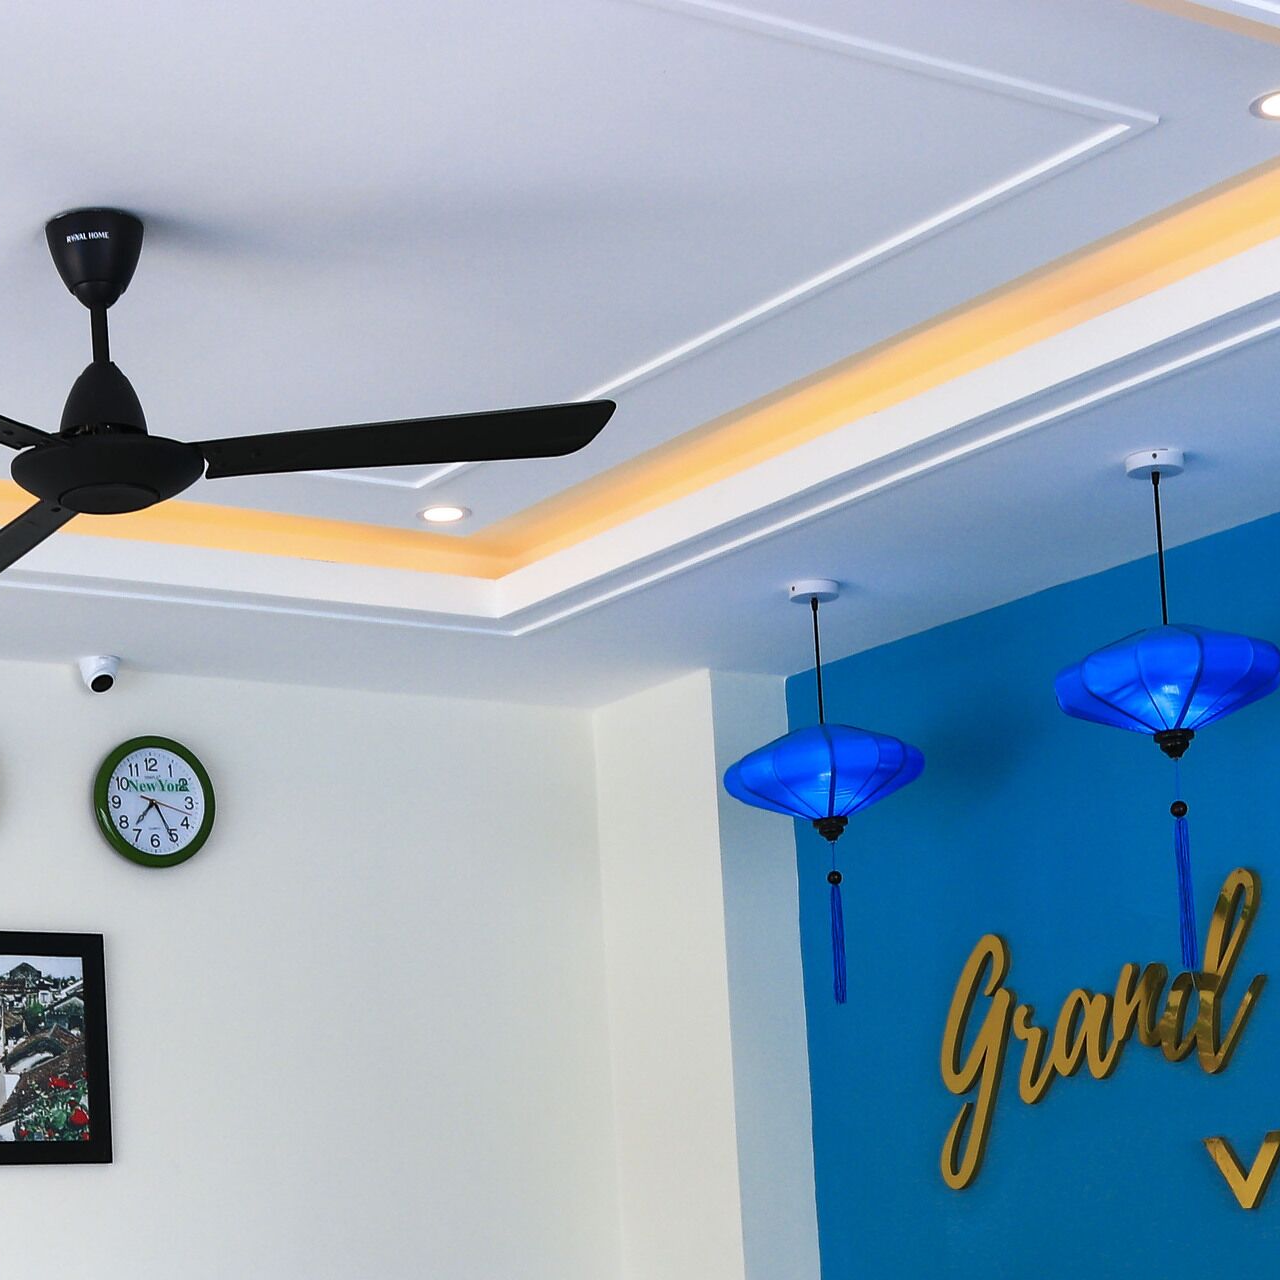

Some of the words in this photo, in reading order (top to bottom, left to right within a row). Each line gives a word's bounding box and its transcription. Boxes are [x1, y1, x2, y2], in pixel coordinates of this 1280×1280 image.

[88, 231, 109, 240] HOME
[129, 763, 139, 777] 11
[144, 758, 158, 771] 12
[168, 764, 172, 777] 1
[116, 777, 129, 790] 10
[129, 780, 156, 792] New
[179, 778, 188, 792] 2
[112, 795, 121, 809] 9
[185, 796, 194, 810] 3
[119, 815, 129, 829] 8
[181, 816, 190, 829] 4
[133, 829, 142, 842] 7
[151, 834, 160, 848] 6
[169, 829, 178, 842] 5
[940, 867, 1267, 1190] Grand
